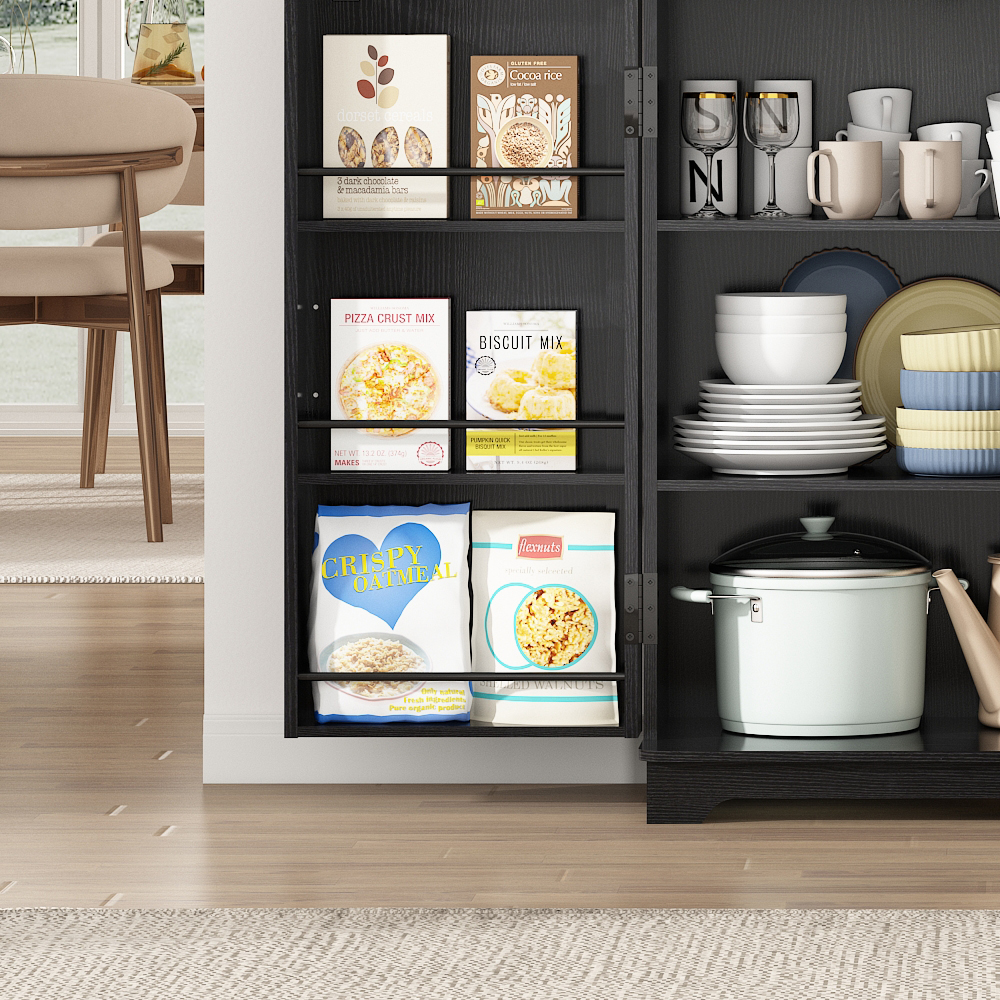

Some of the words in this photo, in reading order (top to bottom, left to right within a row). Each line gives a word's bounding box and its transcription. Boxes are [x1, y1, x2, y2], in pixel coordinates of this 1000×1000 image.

[510, 70, 541, 80] Cocoa
[544, 70, 562, 80] rice
[337, 109, 381, 122] dorset
[384, 109, 433, 122] cereals
[344, 177, 362, 185] dark
[364, 177, 398, 185] chocolate
[689, 160, 723, 202] N
[346, 186, 390, 194] macadamia
[391, 186, 408, 194] bars
[344, 314, 374, 323] PIZZA
[378, 314, 412, 323] CRUST
[416, 314, 434, 323] MIX
[480, 336, 532, 349] BISCUIT
[541, 336, 562, 349] MIX
[518, 538, 560, 555] flexnuts
[322, 545, 423, 579] CRISPY
[354, 562, 458, 593] OATMEAL
[532, 681, 604, 690] WALNUTS
[408, 704, 436, 712] organic
